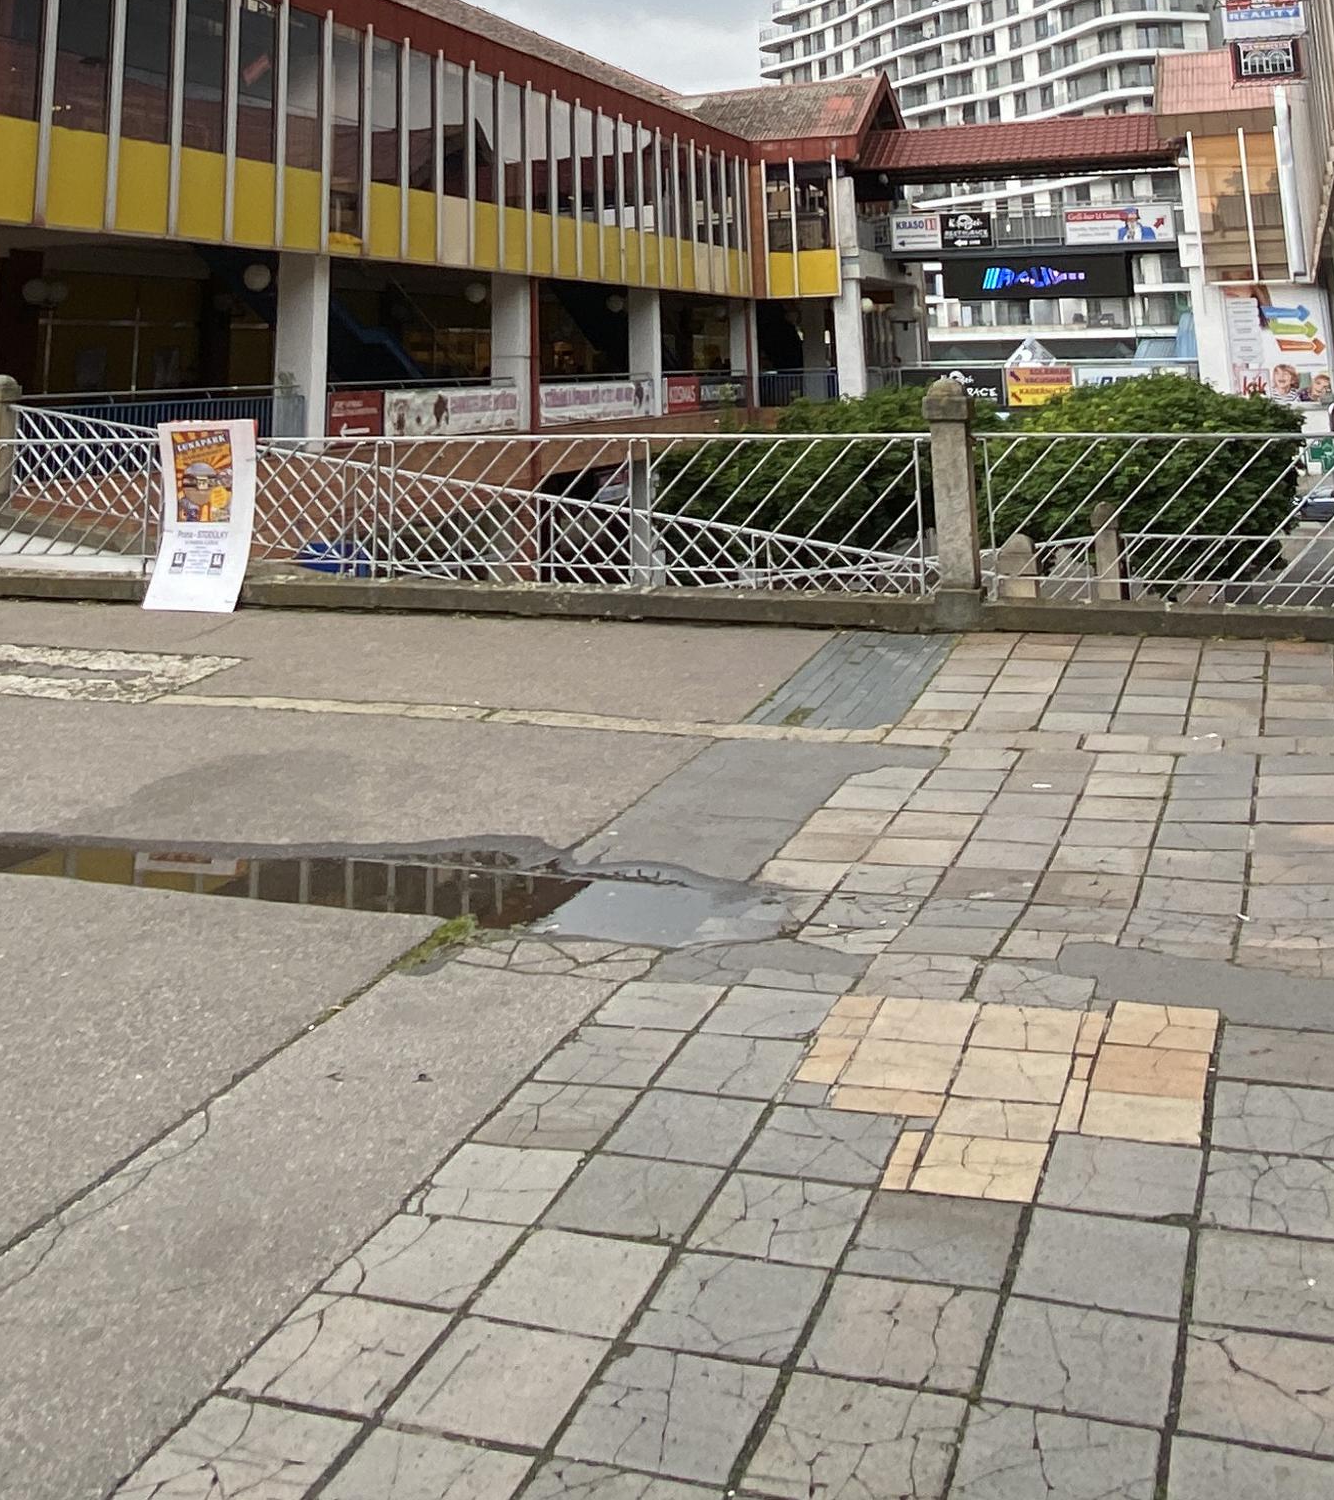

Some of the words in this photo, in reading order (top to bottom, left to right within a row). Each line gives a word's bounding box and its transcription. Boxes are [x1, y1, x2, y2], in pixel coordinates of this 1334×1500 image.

[1229, 8, 1295, 20] REALITY
[896, 219, 925, 230] KRASO
[177, 434, 225, 452] LUNAPARK
